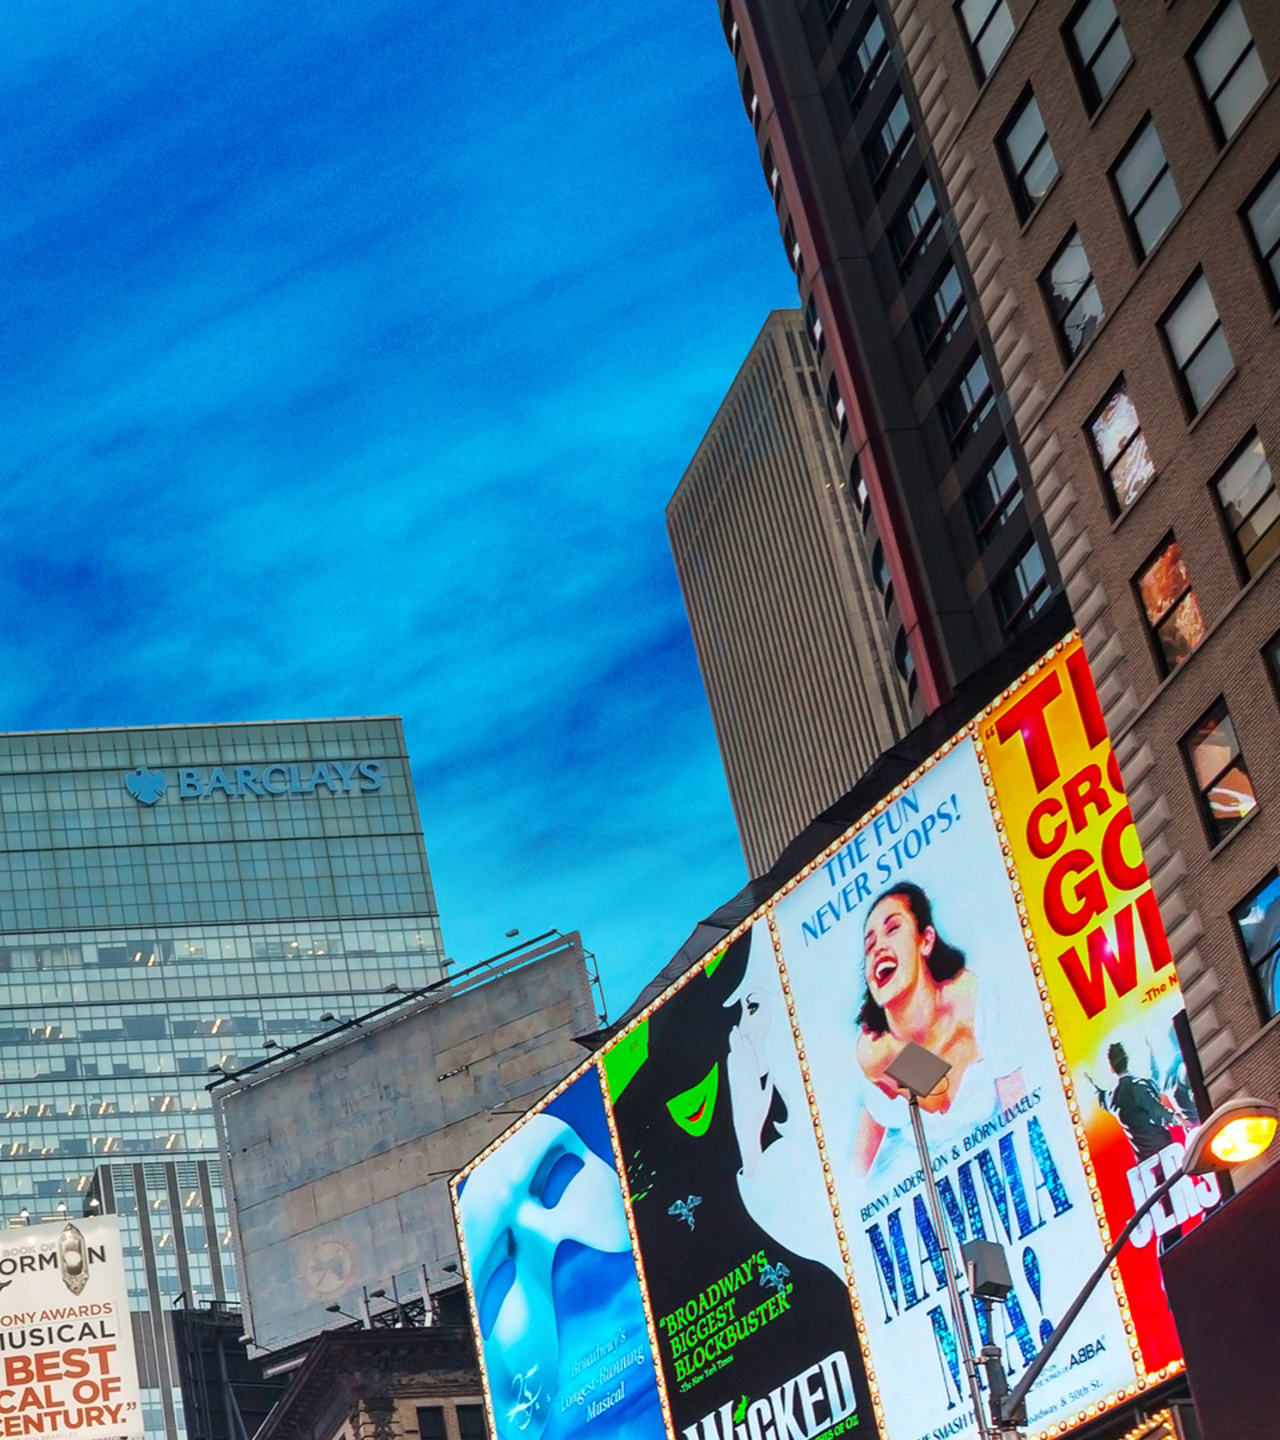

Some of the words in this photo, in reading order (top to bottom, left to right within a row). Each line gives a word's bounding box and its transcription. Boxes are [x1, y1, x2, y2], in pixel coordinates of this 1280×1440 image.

[177, 760, 384, 799] BARCLAYS
[822, 831, 870, 887] THE
[872, 788, 920, 847] FUN
[801, 871, 872, 948] NEVER
[876, 794, 961, 885] STOPS!
[865, 1114, 1074, 1325] MAMMA
[39, 1302, 113, 1322] AWARDS
[669, 1297, 736, 1361] BIGGEST
[4, 1344, 117, 1387] BEST
[1068, 1340, 1106, 1371] ABBA
[73, 1377, 121, 1404] OF
[585, 1380, 627, 1424] Musical
